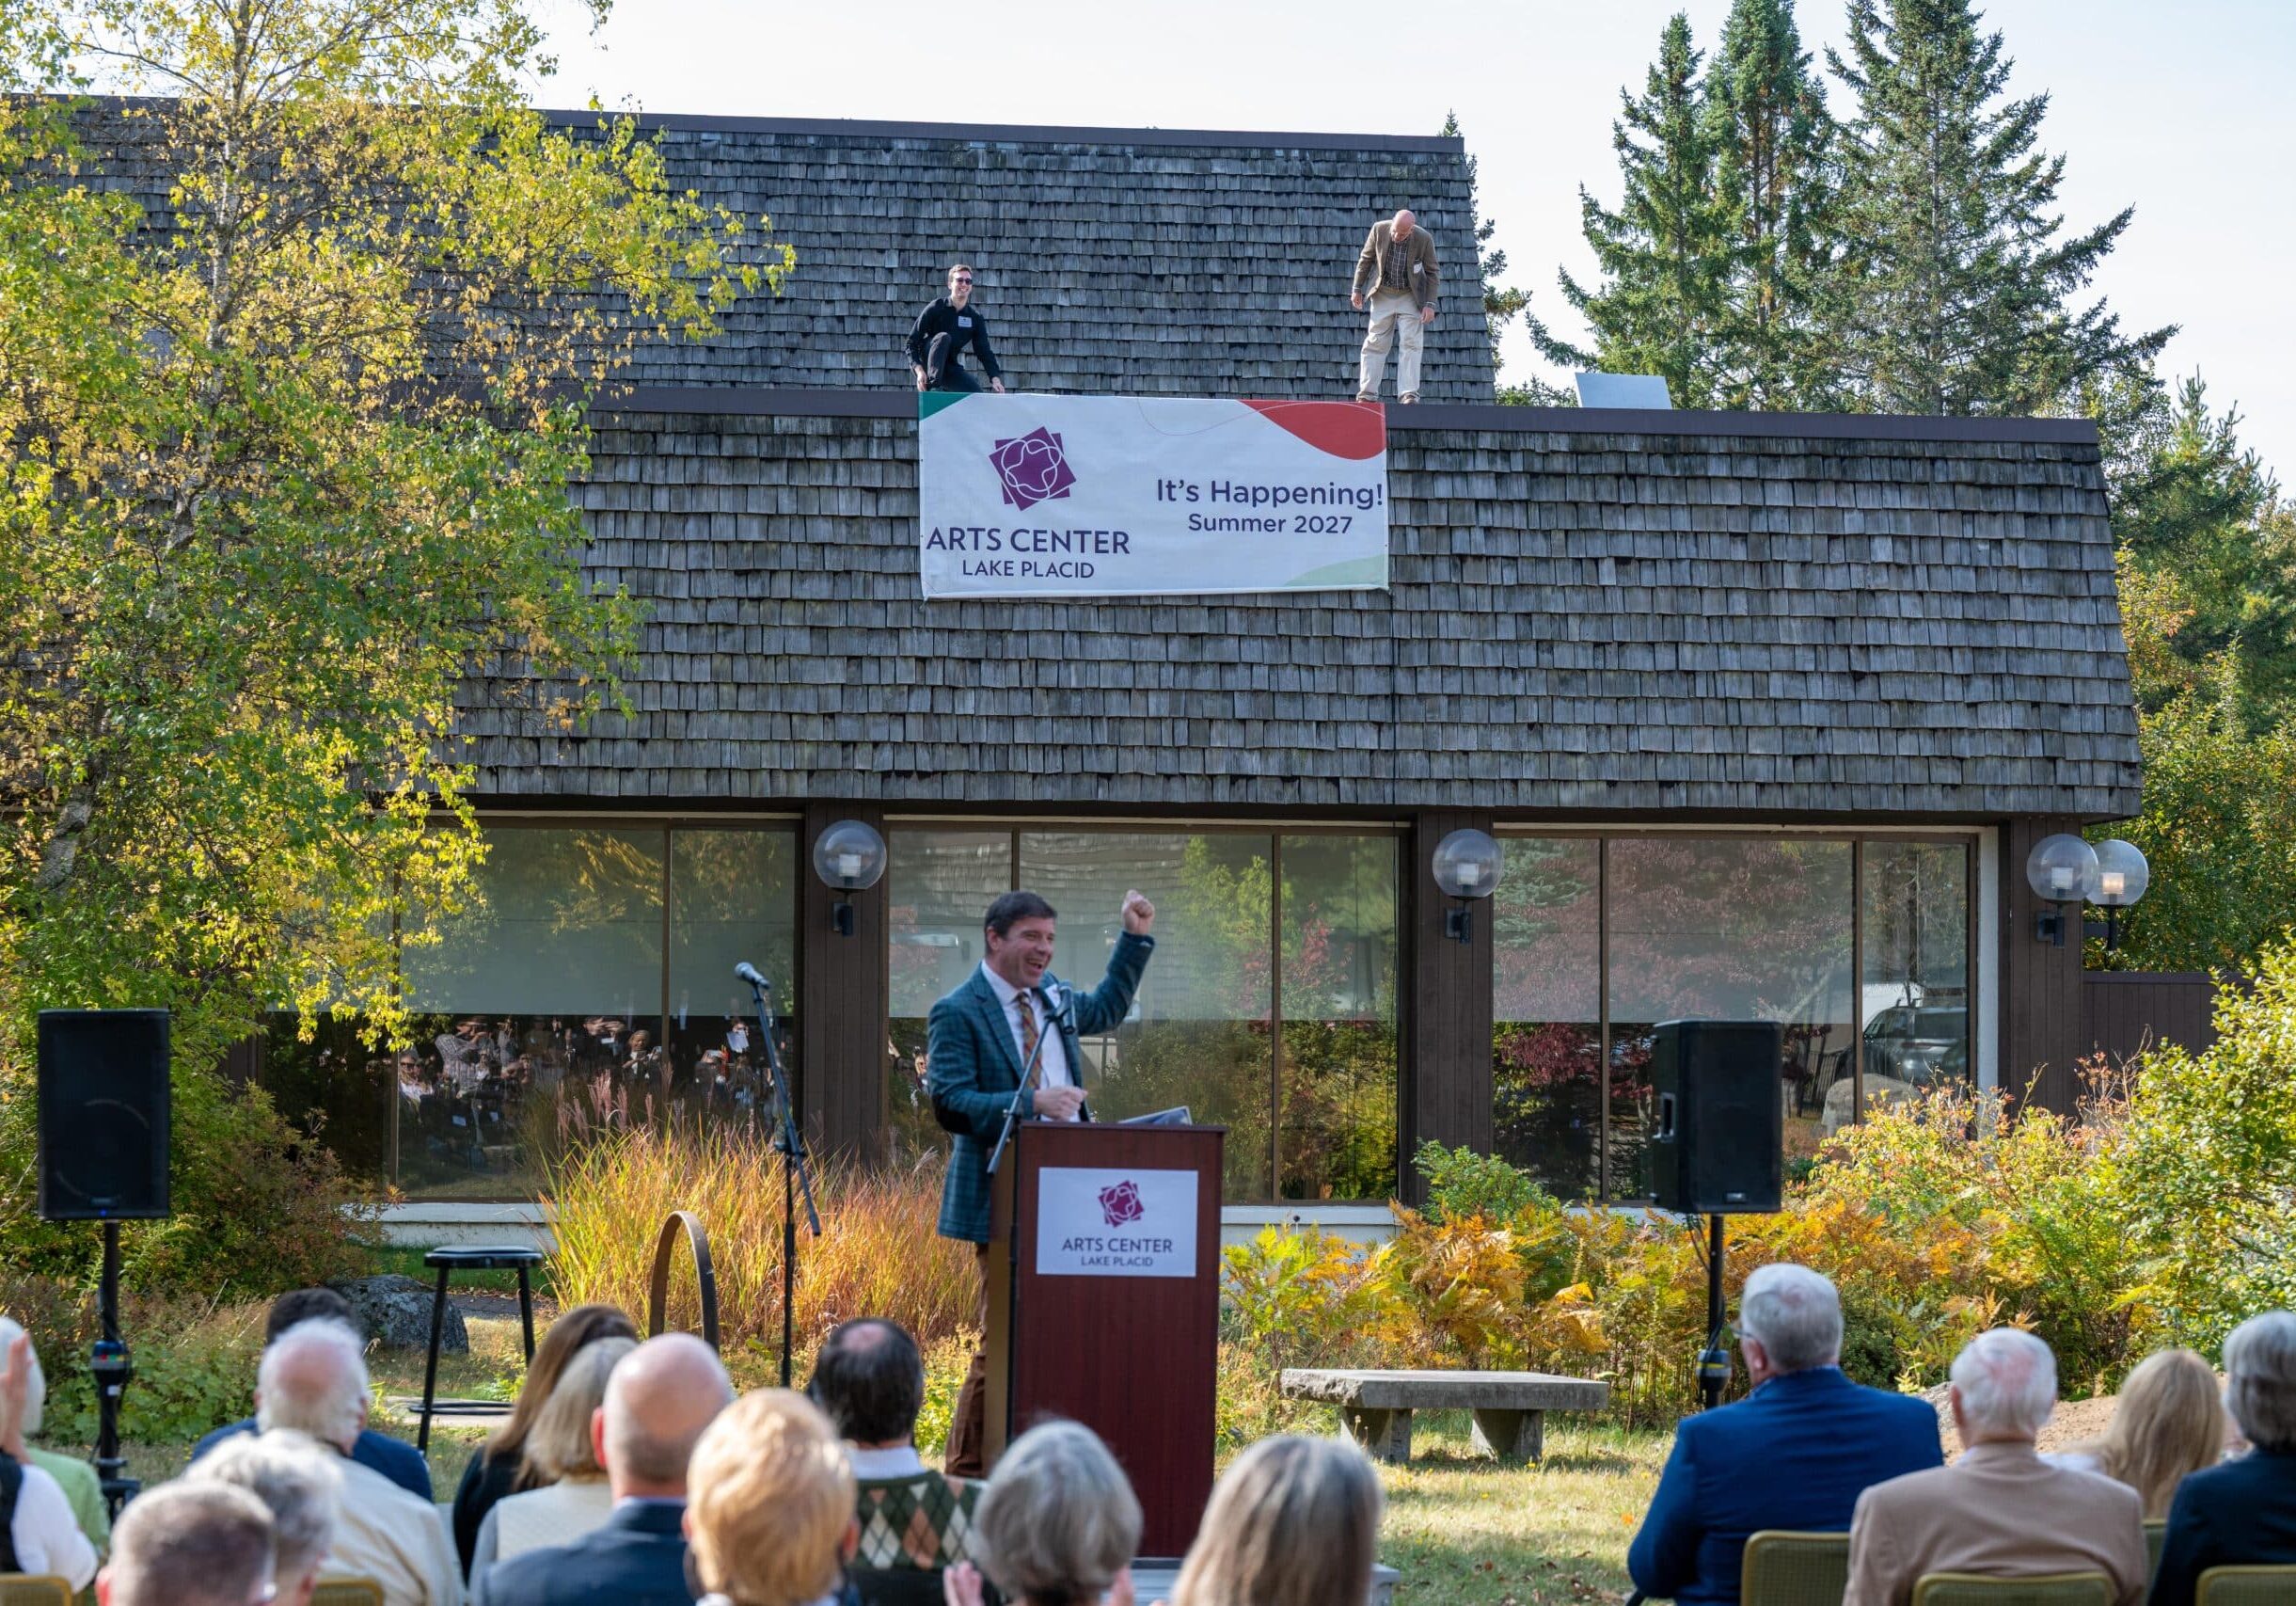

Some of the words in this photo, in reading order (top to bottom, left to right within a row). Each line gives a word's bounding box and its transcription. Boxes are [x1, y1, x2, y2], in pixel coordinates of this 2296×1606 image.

[1157, 478, 1199, 502] It’s
[1211, 480, 1383, 511] Happening!
[1188, 513, 1287, 533] Summer
[1293, 515, 1353, 534] 2027
[926, 527, 1002, 551] ARTS
[1010, 528, 1131, 554] CENTER
[962, 560, 1015, 577] LAKE
[1021, 561, 1095, 579] PLACID
[1062, 1237, 1103, 1252] ARTS
[1107, 1238, 1173, 1253] CENTER
[1081, 1256, 1110, 1266] LAKE
[1113, 1256, 1154, 1267] PLACID
